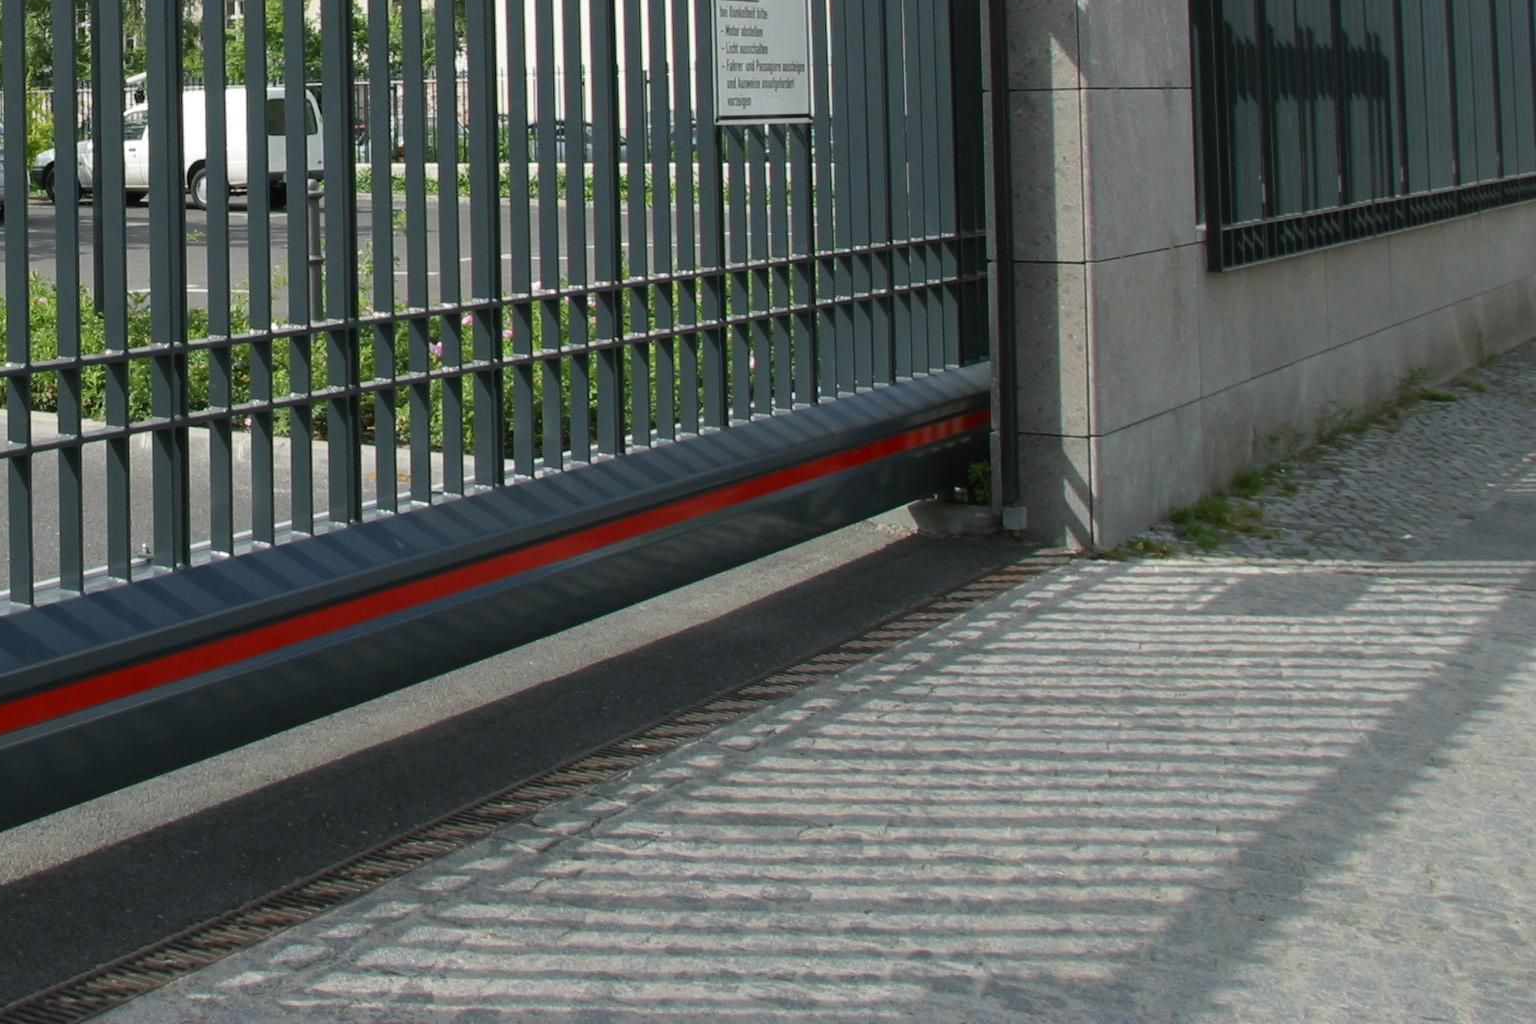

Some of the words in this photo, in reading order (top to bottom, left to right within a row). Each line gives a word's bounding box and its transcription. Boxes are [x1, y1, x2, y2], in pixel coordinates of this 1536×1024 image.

[729, 6, 755, 18] Dunkelheit
[725, 25, 739, 36] Motor
[726, 42, 738, 54] Licht
[726, 59, 743, 72] Fahrer
[746, 60, 755, 72] und
[727, 77, 736, 88] und
